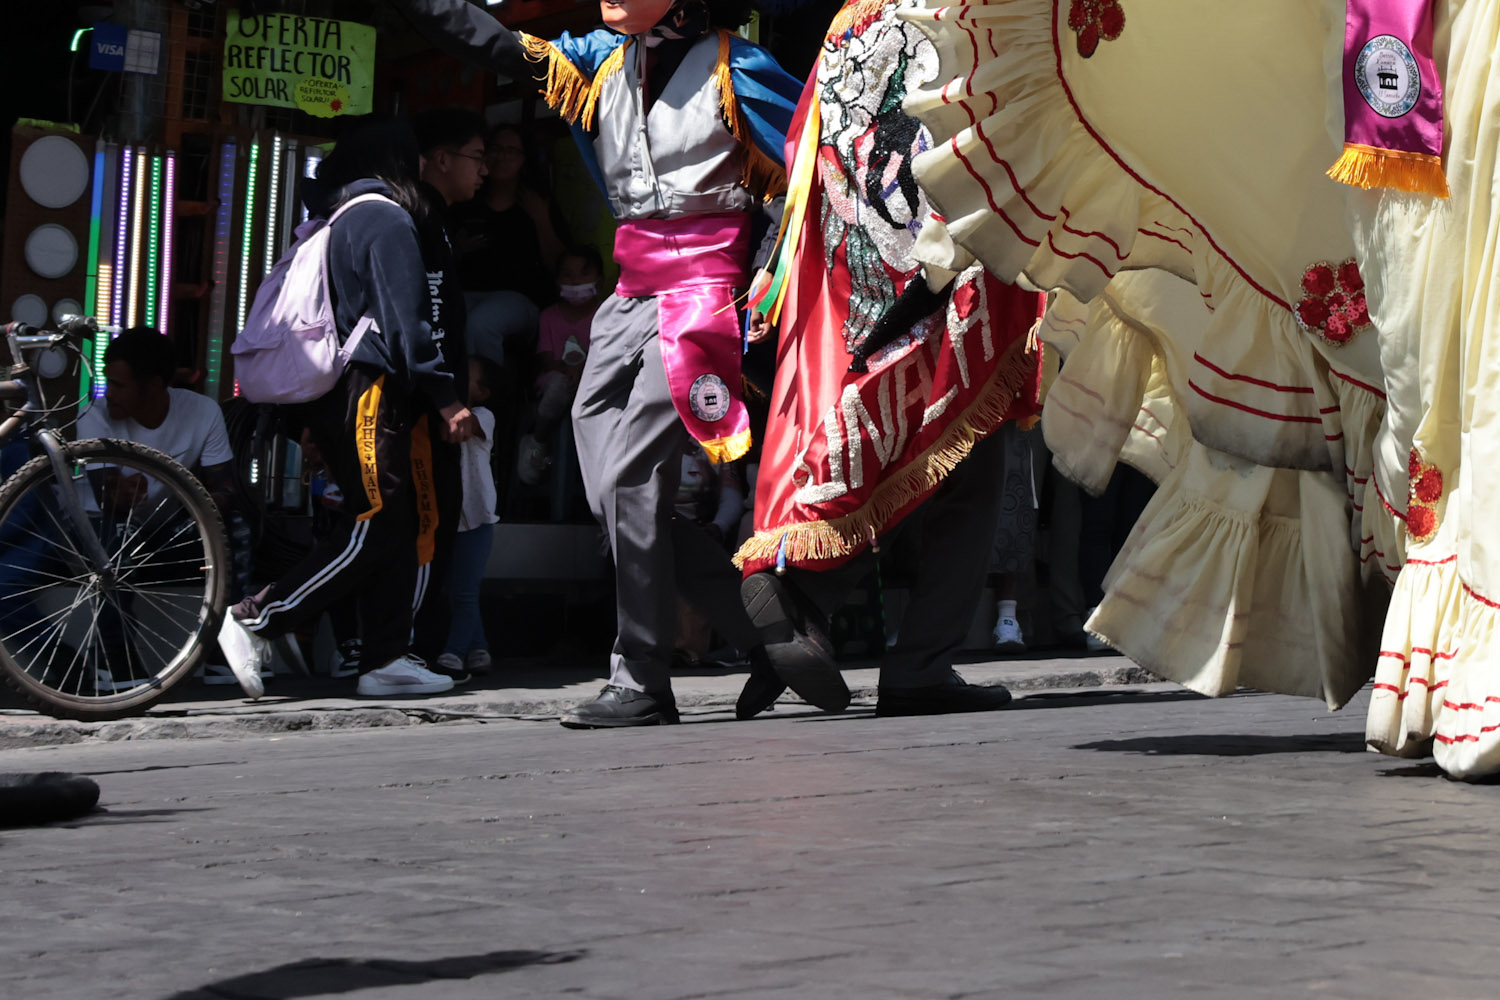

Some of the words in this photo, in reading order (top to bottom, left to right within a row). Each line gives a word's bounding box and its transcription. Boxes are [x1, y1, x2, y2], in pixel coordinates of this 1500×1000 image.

[238, 14, 341, 50] OFERTA
[96, 42, 124, 57] VISA
[228, 45, 352, 85] REFLECTOR
[229, 76, 289, 102] SOLAR
